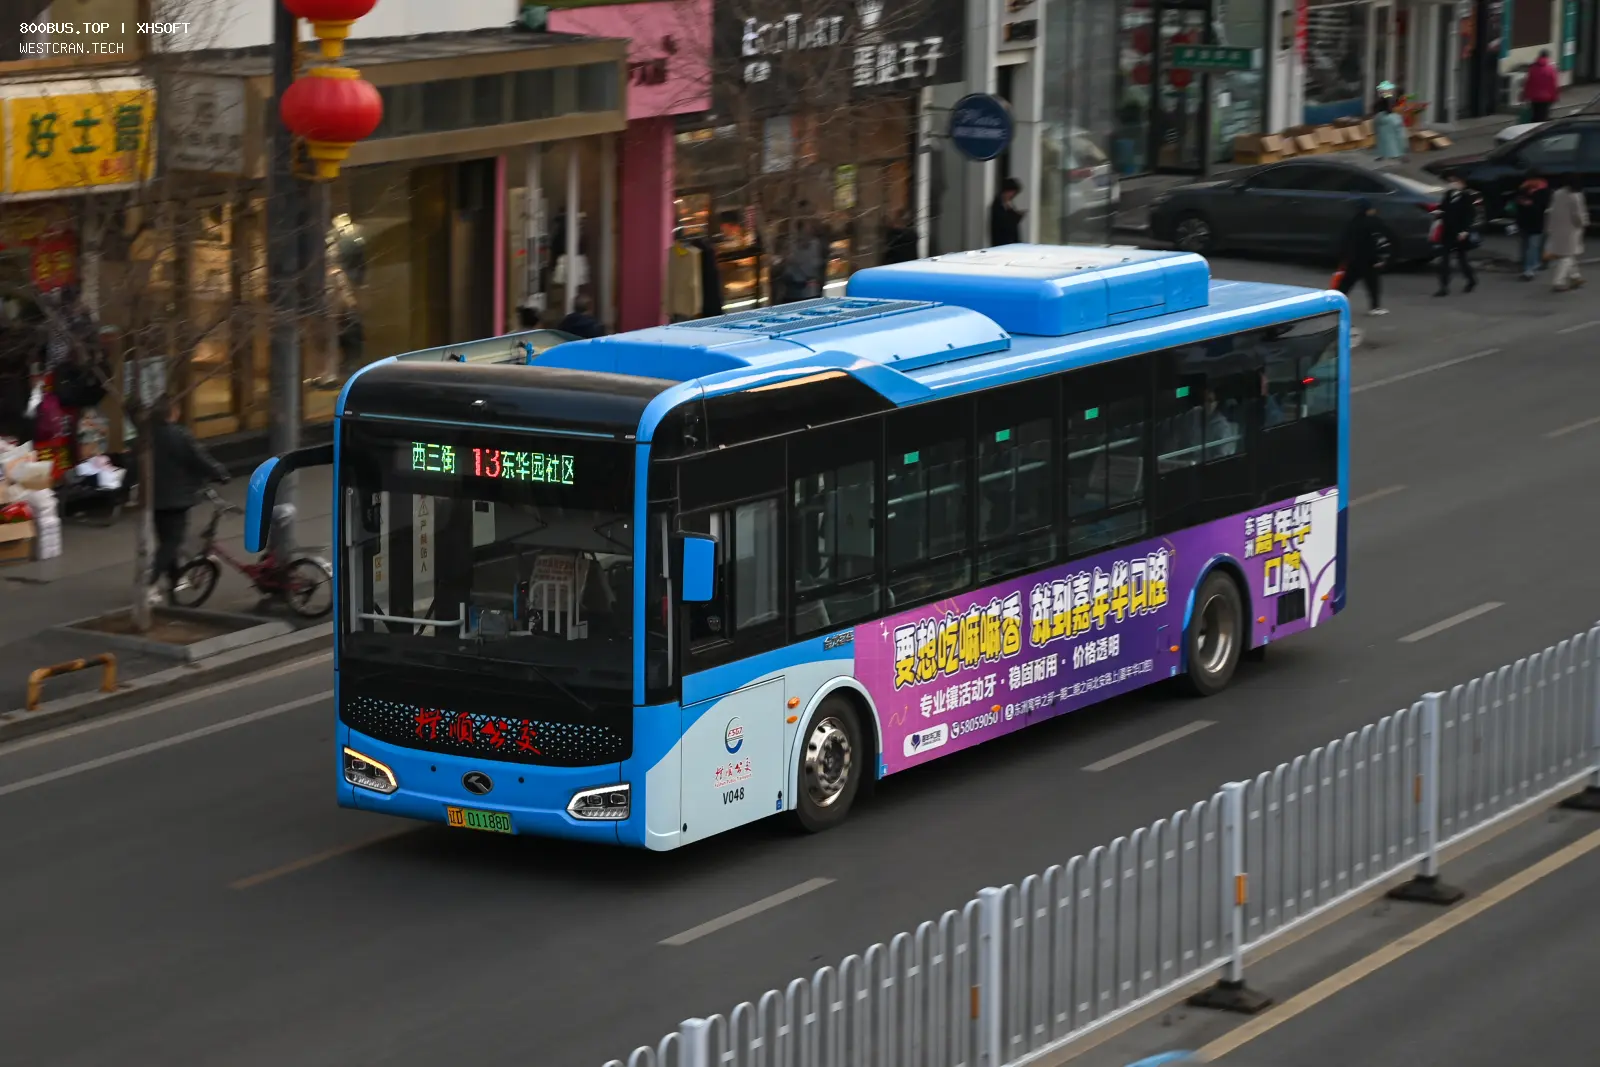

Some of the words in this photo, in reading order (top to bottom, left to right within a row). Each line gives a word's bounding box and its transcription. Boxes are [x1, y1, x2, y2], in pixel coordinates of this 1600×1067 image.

[412, 441, 455, 474] 西三街
[473, 448, 500, 477] 13
[501, 451, 574, 484] 东华园社区
[895, 591, 1021, 690] 要想吃嘛嘛香
[1030, 549, 1168, 647] 就到嘉年华口腔
[919, 673, 997, 719] 专业镶活动牙
[1008, 653, 1058, 691] 稳固耐用
[1072, 634, 1121, 670] 价格透明
[959, 711, 998, 735] 58059050
[722, 787, 744, 805] V048
[467, 811, 510, 831] 01188D
